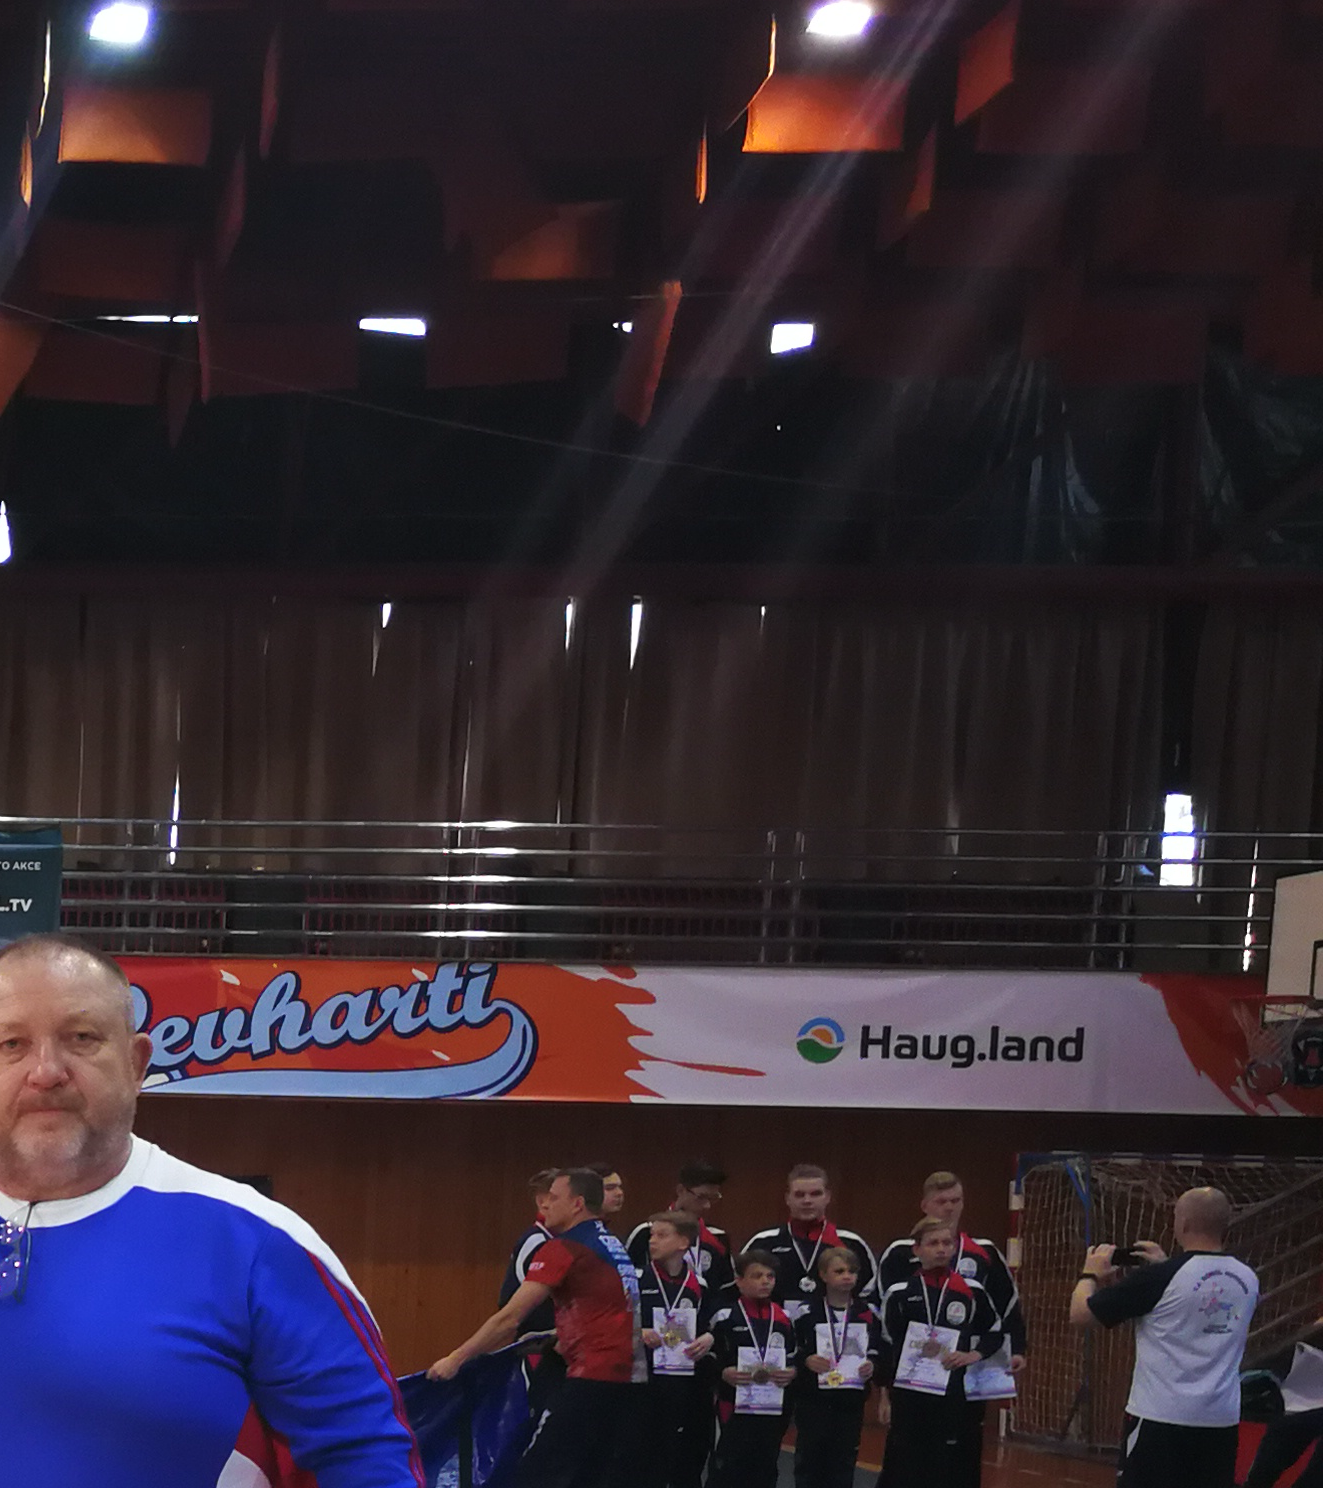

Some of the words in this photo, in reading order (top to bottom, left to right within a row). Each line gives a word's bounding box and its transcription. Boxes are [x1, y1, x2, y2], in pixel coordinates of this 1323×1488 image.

[12, 861, 42, 871] AKCE
[131, 961, 502, 1068] evharti
[859, 1024, 1085, 1069] Haug.land
